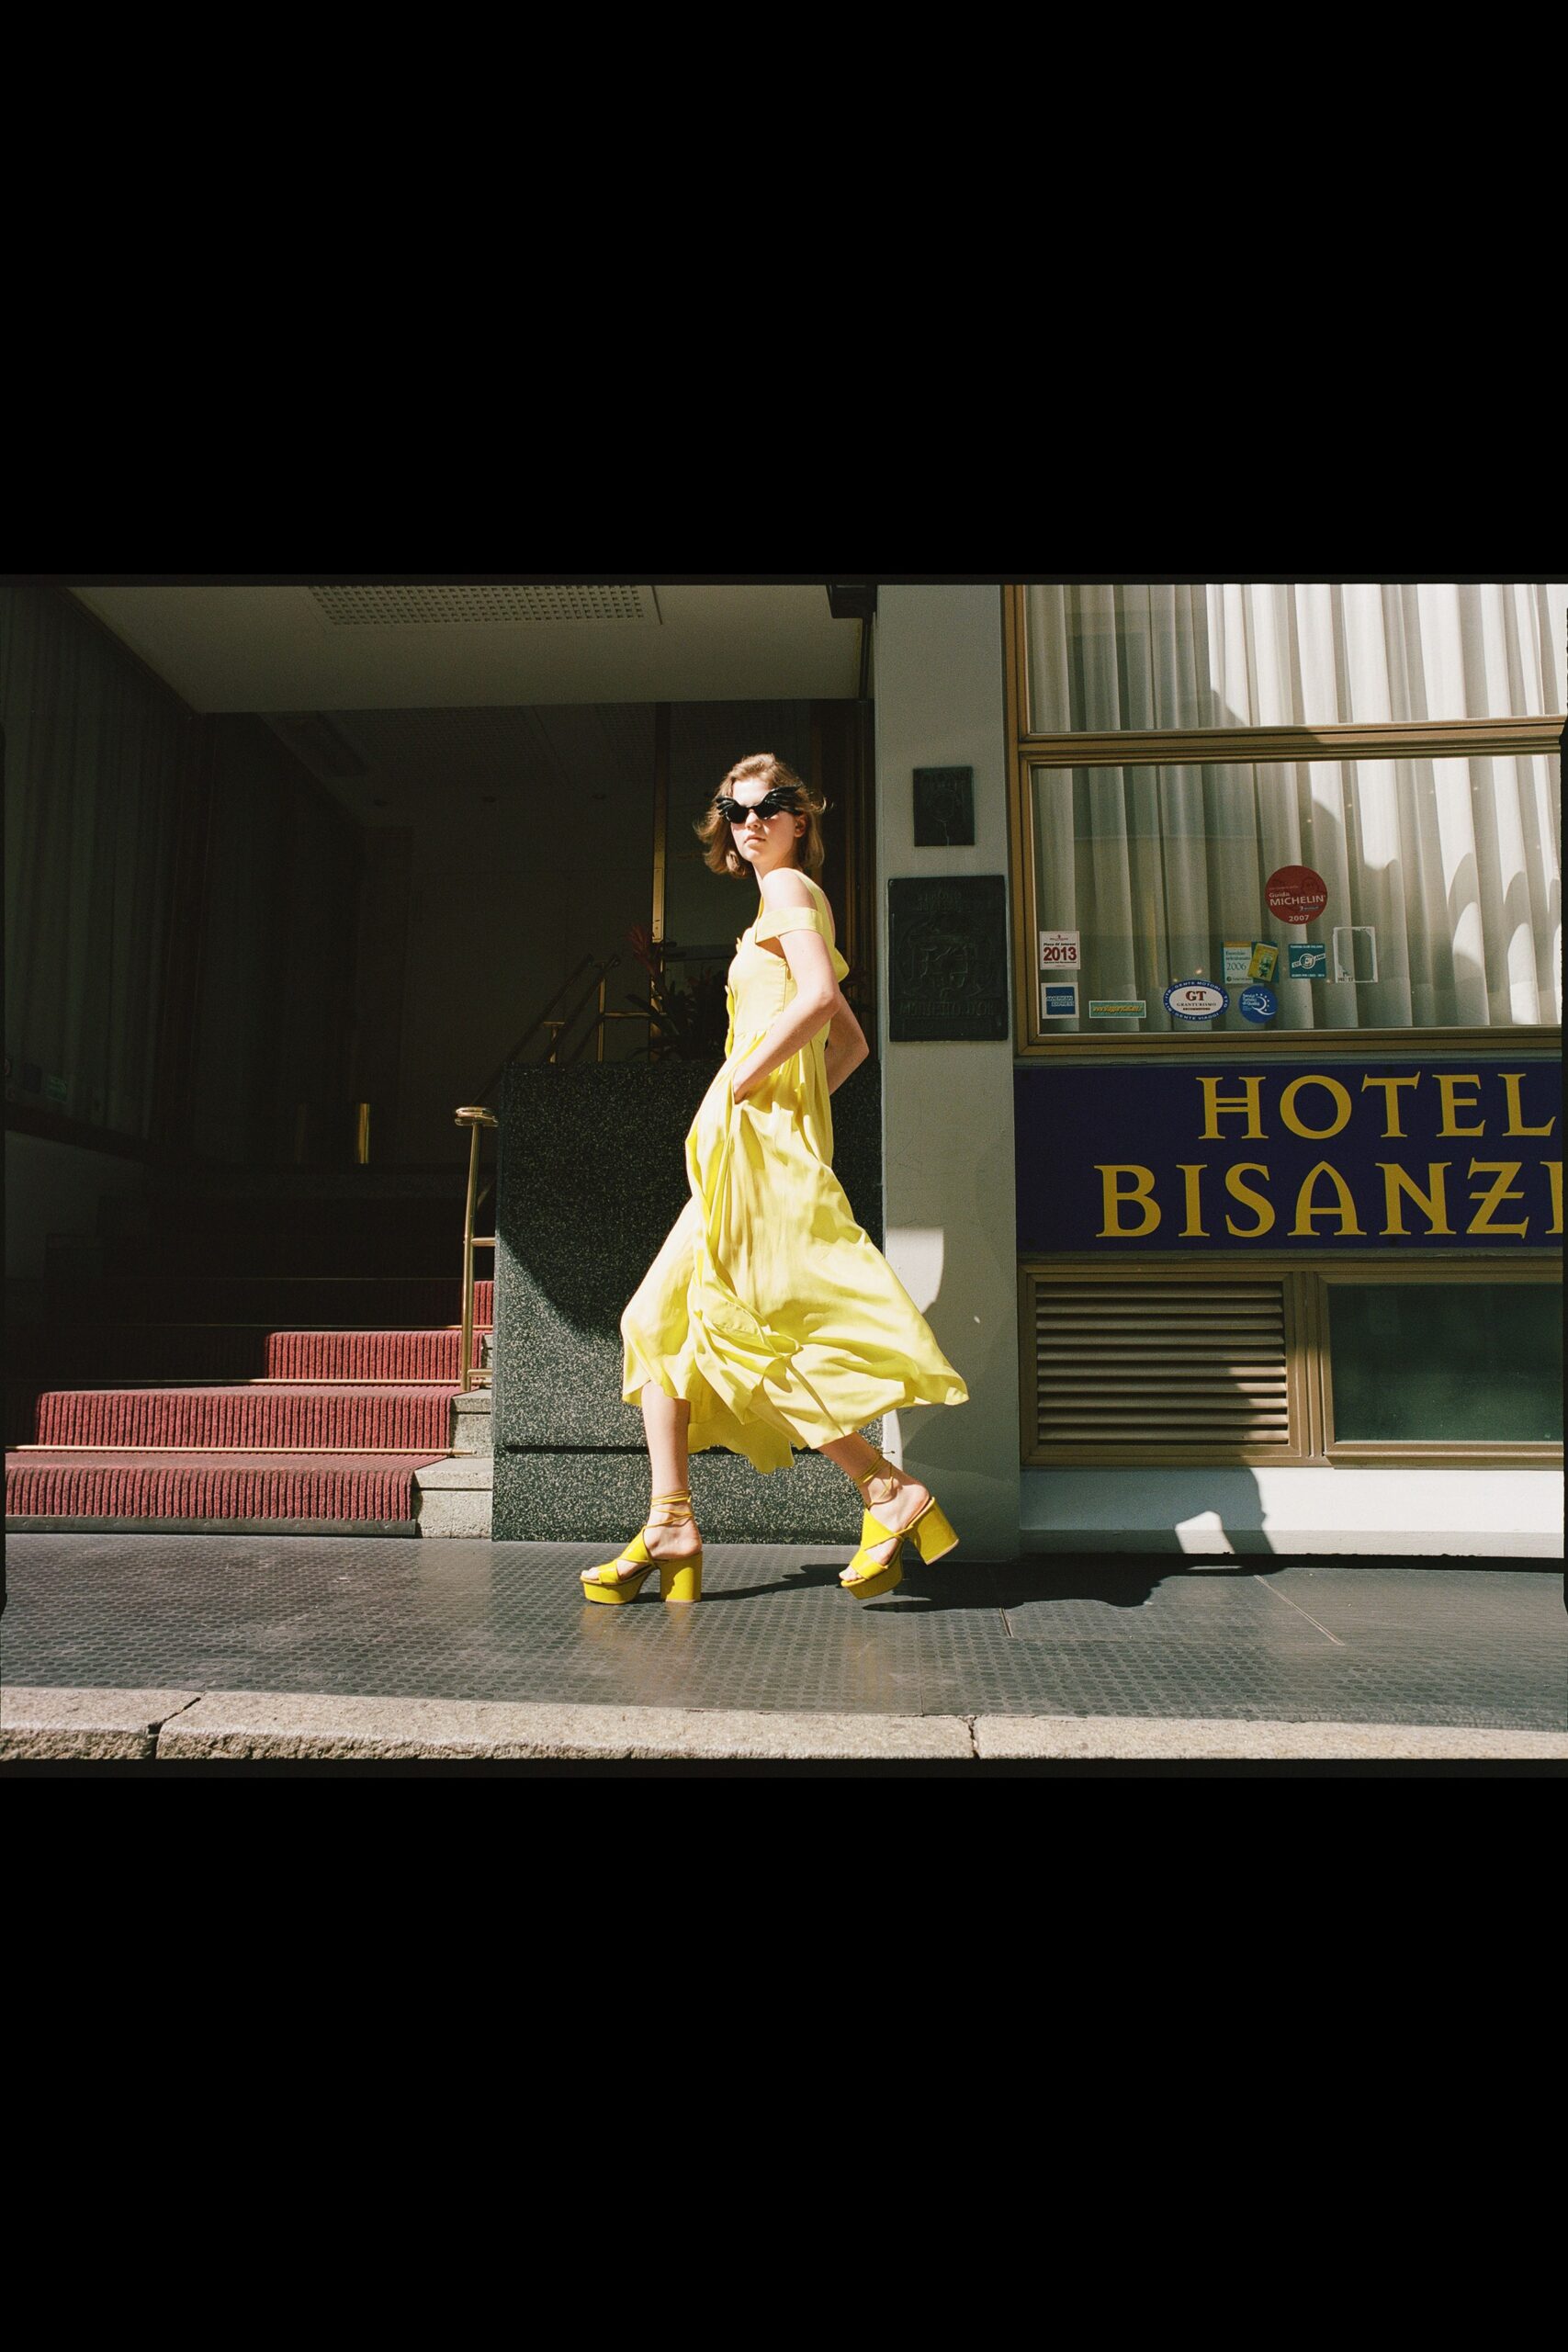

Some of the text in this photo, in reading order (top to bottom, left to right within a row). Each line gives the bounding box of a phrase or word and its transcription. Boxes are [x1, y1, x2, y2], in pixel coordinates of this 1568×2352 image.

[1269, 895, 1324, 906] MICHELIN
[1289, 914, 1309, 922] 2007
[1043, 946, 1077, 961] 2013
[1226, 962, 1247, 970] 2006
[1197, 981, 1221, 990] MOTORI
[1186, 990, 1207, 1001] GT
[1196, 1071, 1556, 1140] HOTEL
